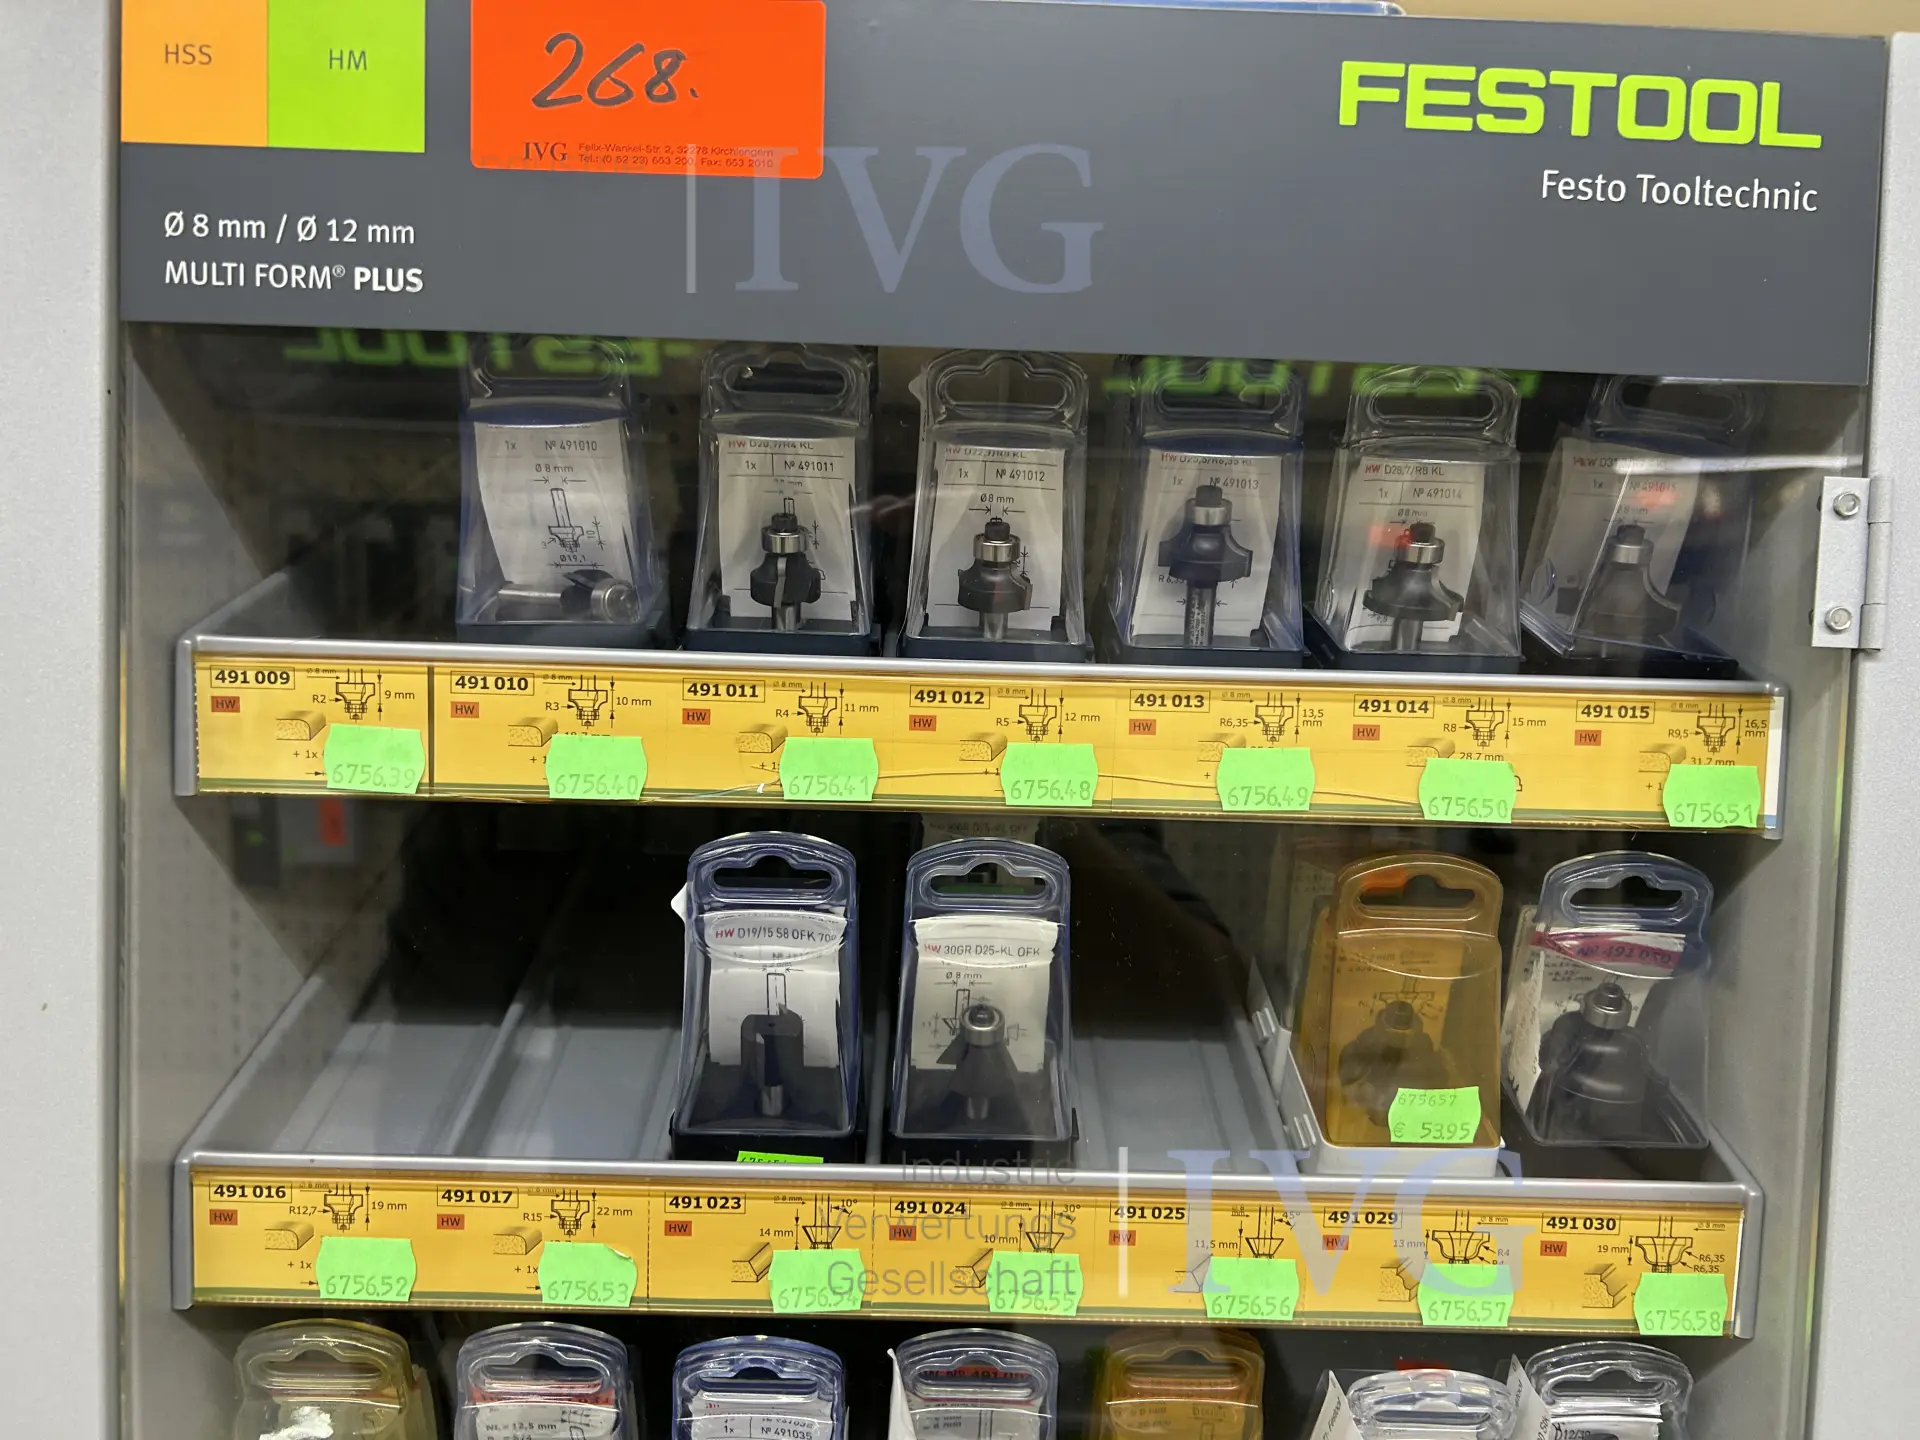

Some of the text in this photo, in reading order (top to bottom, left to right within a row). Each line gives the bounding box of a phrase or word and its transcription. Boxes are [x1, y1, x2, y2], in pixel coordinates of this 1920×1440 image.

[164, 44, 212, 65] HSS
[330, 50, 368, 71] HM
[1339, 60, 1822, 149] FESTOOL
[523, 142, 567, 162] IVG
[1542, 169, 1818, 213] Festo Tooltechnic
[164, 210, 415, 245] Ø 8 mm Ø 12 mm
[164, 261, 246, 288] MULTI
[354, 268, 424, 293] PLUS
[560, 440, 597, 451] 491010
[798, 461, 834, 472] 491011
[1009, 469, 1045, 481] 491012
[215, 670, 290, 685] 491 009
[455, 675, 529, 691] 491 010
[385, 690, 415, 699] 9 mm
[688, 683, 758, 698] 491 011
[312, 695, 326, 703] R2
[616, 697, 652, 706] 10 mm
[914, 689, 985, 705] 491 012
[1134, 693, 1205, 708] 491 013
[216, 699, 236, 709] HW
[546, 702, 560, 711] R3
[845, 703, 856, 712] 11
[1358, 699, 1429, 714] 491 014
[455, 705, 475, 715] HW
[776, 709, 789, 717] R4
[1302, 709, 1324, 720] 13,5
[1581, 704, 1650, 719] 491 015
[687, 711, 706, 721] HW
[1065, 712, 1100, 722] 12 mm
[913, 718, 932, 728] HW
[996, 718, 1009, 727] R5
[1133, 722, 1151, 732] HW
[1220, 718, 1248, 728] R6,35
[1302, 719, 1322, 727] mm
[1443, 724, 1457, 732] R8
[1512, 718, 1546, 727] 15 mm
[1745, 719, 1767, 729] 16,5
[1357, 727, 1376, 737] HW
[1579, 733, 1598, 742] HW
[1668, 729, 1689, 739] R9,5
[1745, 729, 1766, 738] mm
[332, 764, 416, 790] 6756.39
[555, 774, 639, 796] 6756.40
[789, 774, 870, 797] 6756.41
[1011, 779, 1091, 801] 6756.48
[1227, 786, 1308, 808] 6756.49
[1428, 797, 1508, 818] 6756.50
[1674, 803, 1754, 824] 6756.51
[715, 928, 735, 939] HW
[792, 929, 816, 942] OFK
[944, 945, 1040, 957] 30GR D25-KL OFK
[1393, 1123, 1406, 1138] €
[214, 1184, 286, 1199] 491 016
[442, 1189, 513, 1204] 491 017
[371, 1201, 407, 1210] 19 mm
[669, 1196, 742, 1210] 491 023
[894, 1200, 966, 1215] 491 024
[289, 1206, 317, 1216] R12,7
[596, 1207, 633, 1216] 22 mm
[1114, 1206, 1186, 1220] 491 025
[213, 1212, 233, 1222] HW
[441, 1217, 460, 1226] HW
[523, 1213, 542, 1221] R15
[1328, 1211, 1398, 1225] 491 029
[669, 1223, 688, 1233] HW
[1546, 1217, 1616, 1231] 491 030
[759, 1228, 794, 1238] 14 mm
[894, 1227, 912, 1238] HW
[1112, 1233, 1131, 1242] HW
[985, 1235, 1018, 1244] 10 mm
[1195, 1240, 1238, 1250] 11,5 mm
[1326, 1238, 1345, 1247] HW
[1393, 1240, 1405, 1248] 13
[1497, 1249, 1510, 1257] R4
[1544, 1244, 1563, 1253] HW
[1597, 1245, 1629, 1254] 19 mm
[1699, 1254, 1725, 1263] R6,35
[1693, 1264, 1720, 1273] R6,35
[325, 1275, 408, 1297] 6756.52
[547, 1280, 629, 1302] 6756.53
[1211, 1296, 1291, 1316] 6756.56
[1428, 1300, 1506, 1322] 6756.57
[1644, 1311, 1721, 1332] 6756.58
[774, 1428, 813, 1440] 491035
